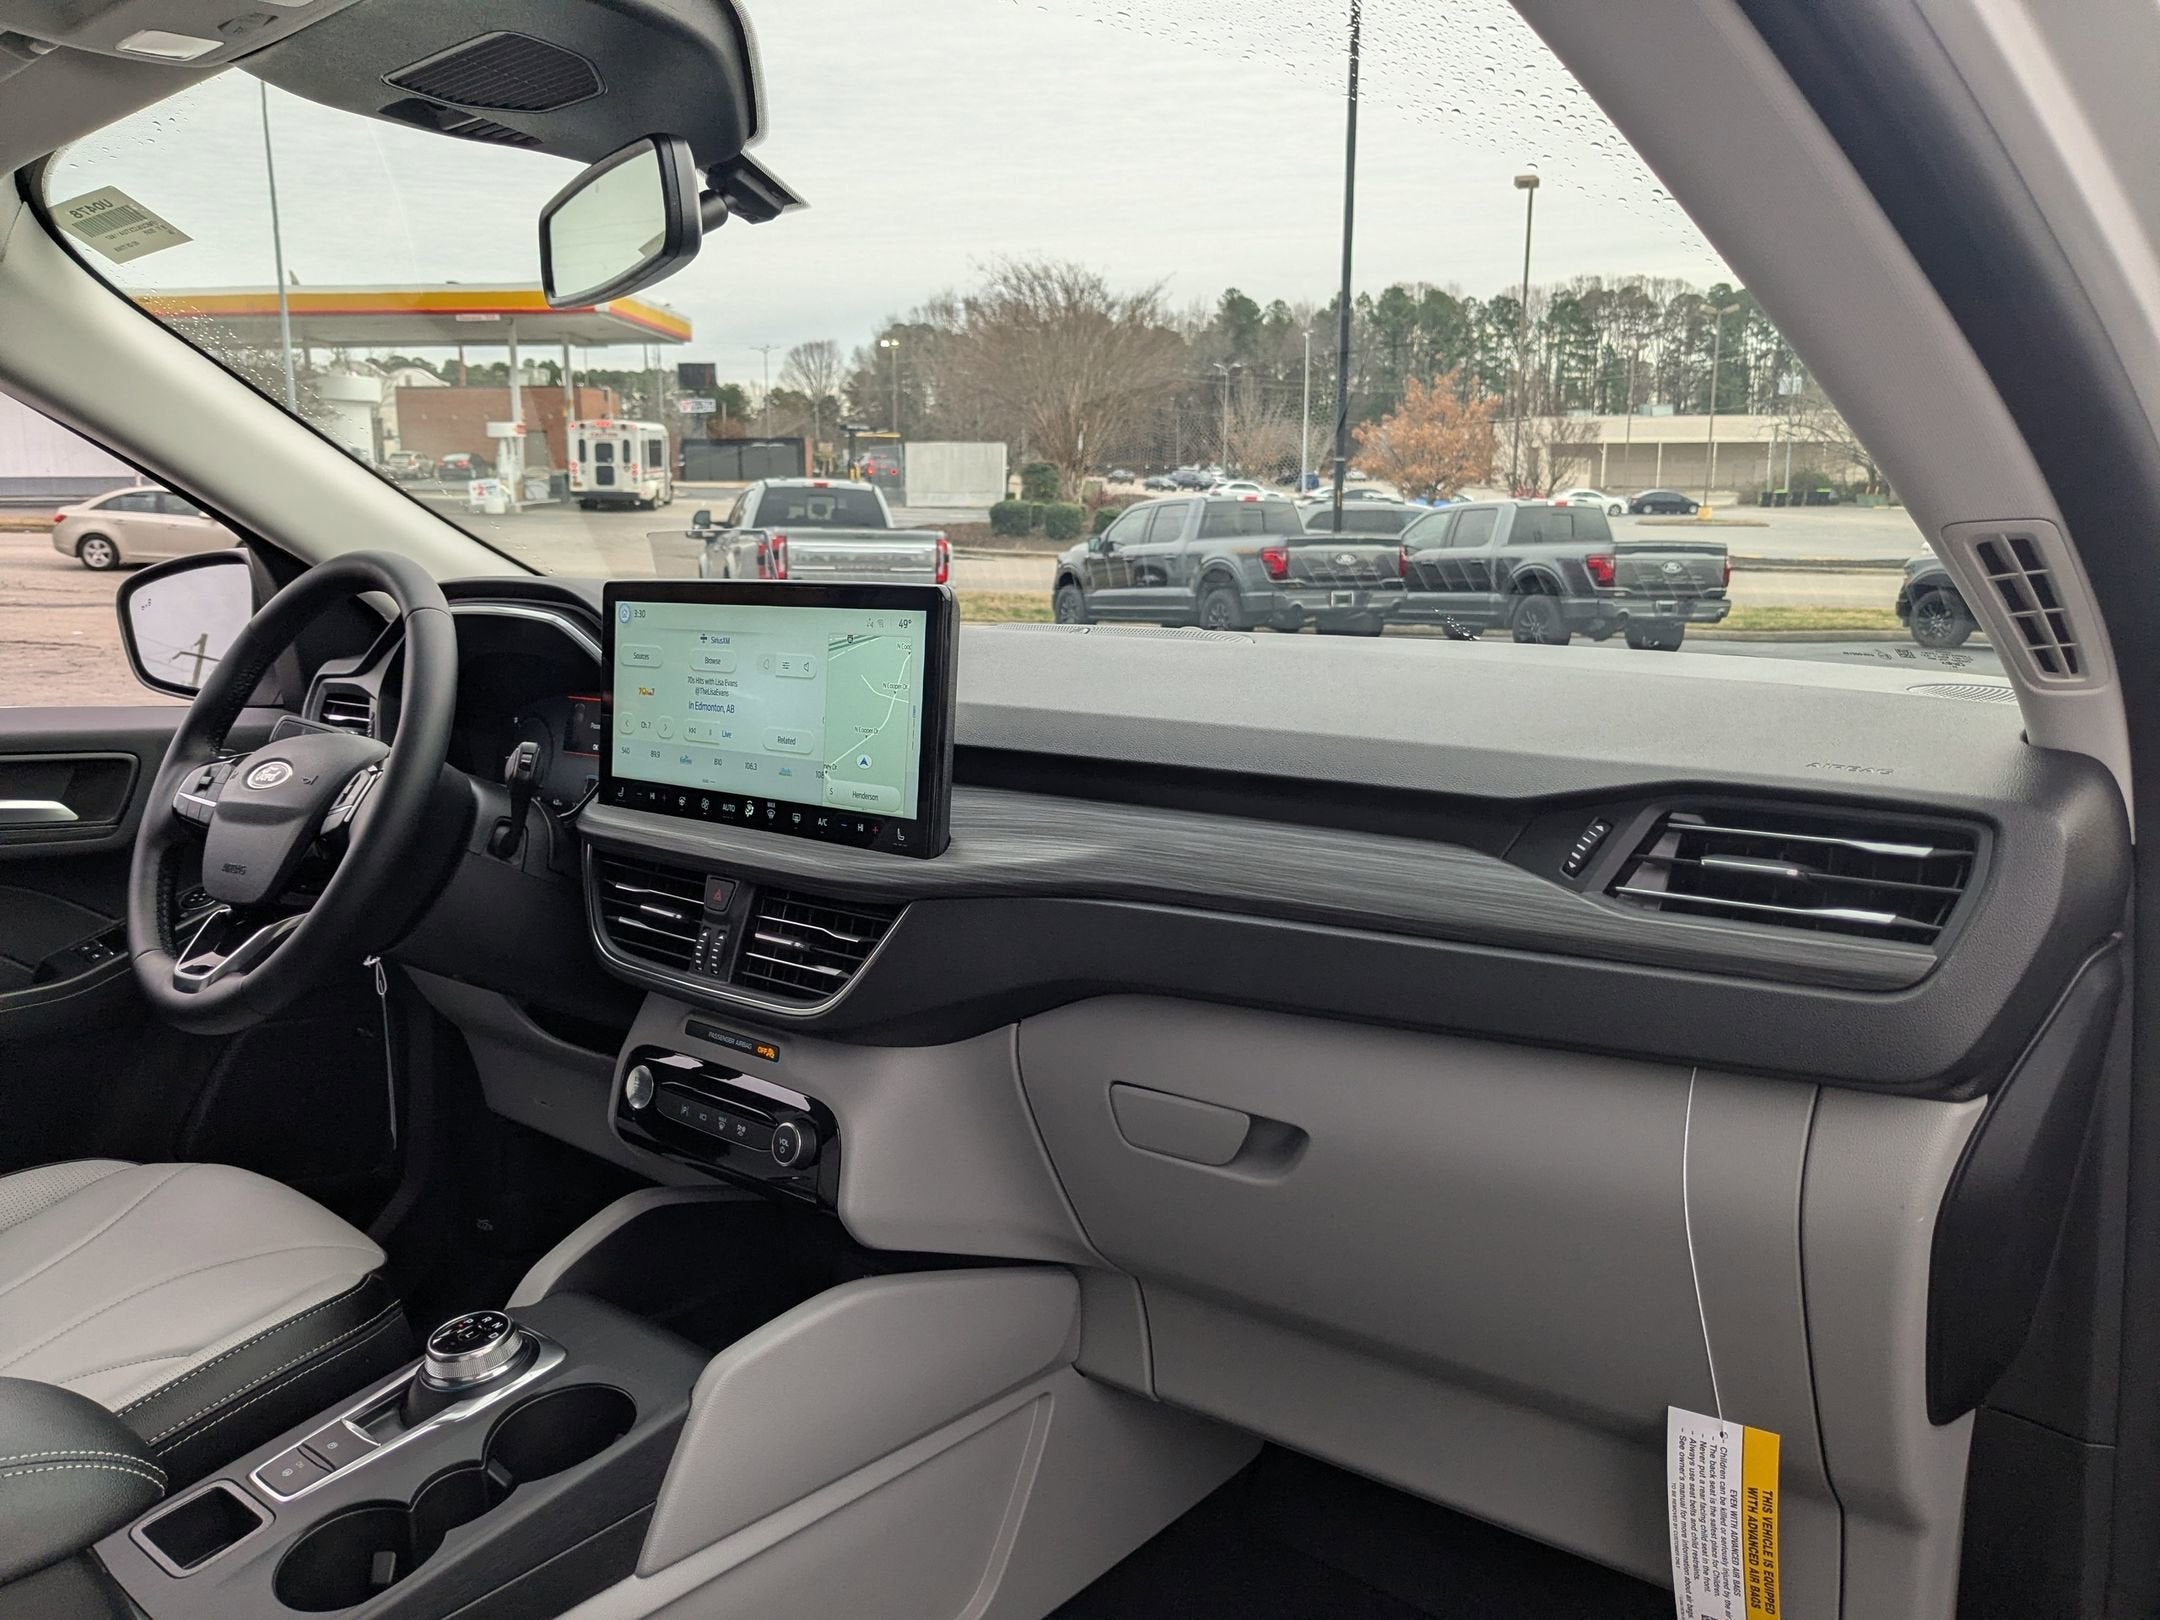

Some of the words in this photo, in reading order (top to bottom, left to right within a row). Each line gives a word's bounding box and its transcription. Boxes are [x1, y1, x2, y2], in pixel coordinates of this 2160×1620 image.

[634, 609, 646, 618] 3:30
[710, 636, 730, 645] SiriusXM
[633, 652, 650, 660] Sources
[704, 656, 721, 665] Browse
[695, 676, 704, 685] Hits
[724, 680, 738, 688] Evans
[688, 700, 695, 709] In
[695, 701, 725, 714] Edmonton,
[726, 704, 735, 713] AB
[722, 730, 732, 738] Live
[778, 736, 796, 745] Related
[744, 762, 758, 770] 106.3
[852, 791, 879, 801] Henderson
[722, 803, 735, 812] AUTO
[818, 818, 827, 826] A/C
[708, 1032, 735, 1044] PASSENGER
[735, 1038, 752, 1049] AIRBAG
[757, 1046, 767, 1054] OFF
[780, 1138, 789, 1147] VOL
[1688, 1438, 1696, 1466] Always
[1720, 1446, 1728, 1479] Children
[1698, 1465, 1706, 1478] put
[1720, 1496, 1727, 1506] be
[1748, 1488, 1758, 1513] WITH
[1762, 1491, 1773, 1513] THIS
[1699, 1502, 1708, 1523] facing
[1720, 1508, 1728, 1527] killed
[1730, 1510, 1738, 1530] WITH
[1690, 1518, 1698, 1532] and
[1710, 1518, 1718, 1539] safest
[1721, 1527, 1726, 1535] or
[1748, 1516, 1759, 1565] ADVANCED
[1762, 1517, 1774, 1557] VEHICLE
[1709, 1540, 1718, 1558] place
[1720, 1536, 1728, 1567] seriously
[1731, 1530, 1739, 1565] ADVANCED
[1692, 1550, 1700, 1580] restraints.
[1764, 1559, 1774, 1568] IS
[1682, 1540, 1690, 1576] information
[1686, 1604, 1694, 1618] bags.
[1722, 1568, 1730, 1589] injured
[1732, 1566, 1740, 1578] AIR
[1750, 1568, 1760, 1583] AIR
[1722, 1591, 1730, 1599] by
[1733, 1580, 1741, 1596] BAGS
[1764, 1570, 1775, 1615] EQUIPPED
[1750, 1585, 1761, 1609] BAGS
